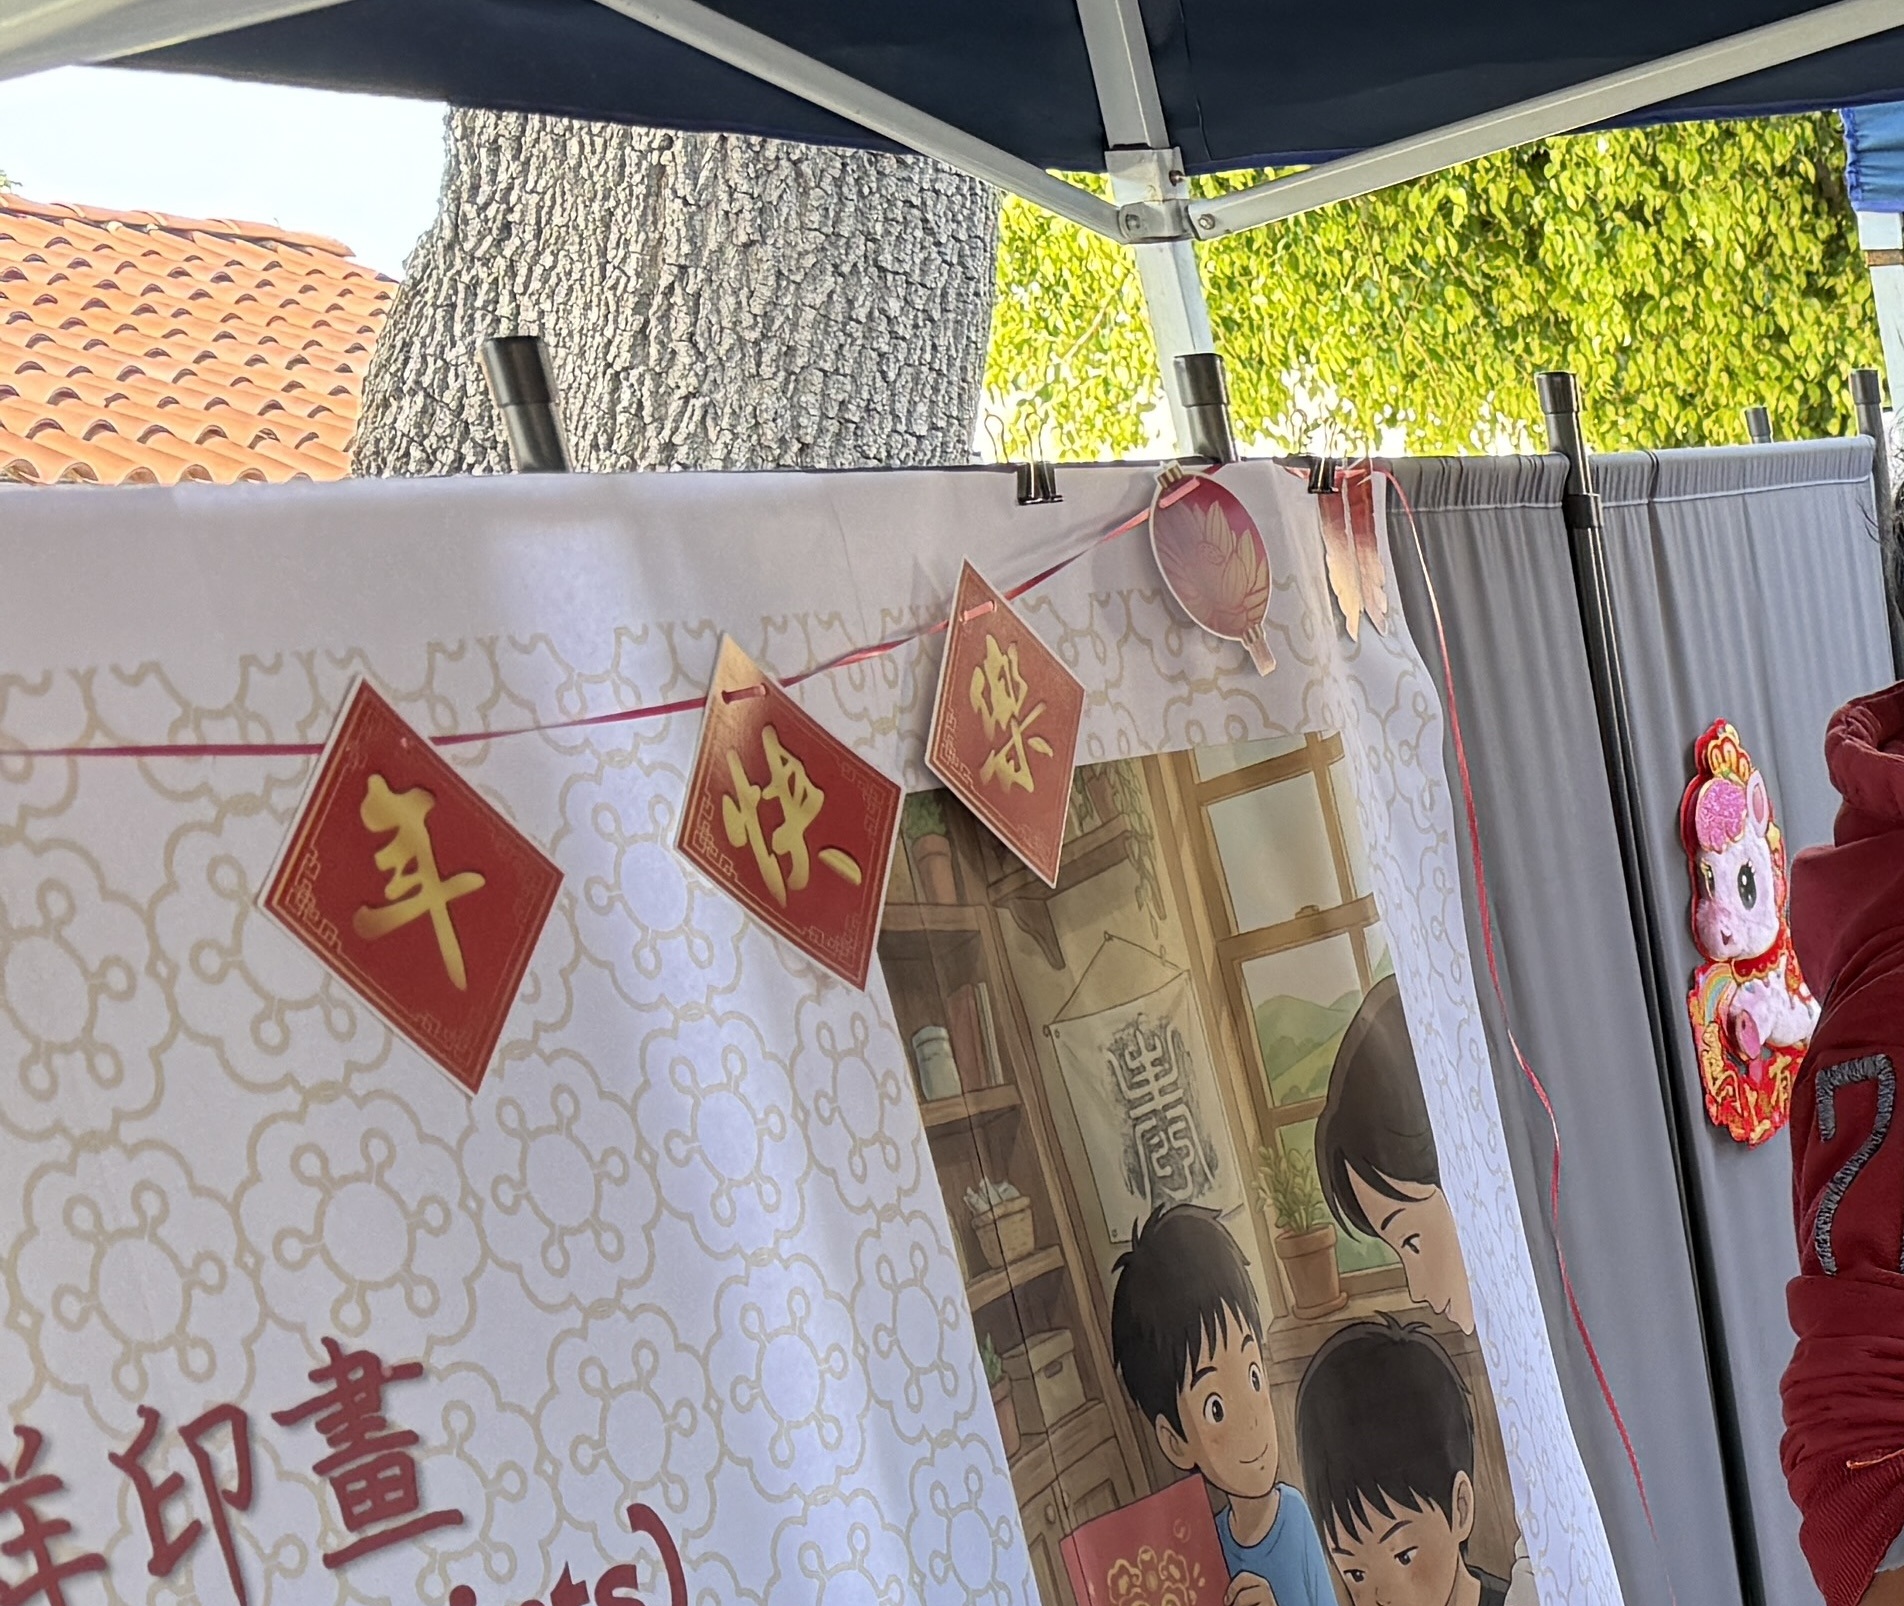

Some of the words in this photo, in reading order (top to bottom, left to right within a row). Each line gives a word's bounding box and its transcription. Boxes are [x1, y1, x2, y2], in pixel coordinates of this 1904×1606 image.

[352, 773, 486, 991] 年
[722, 724, 862, 908] 快
[970, 633, 1054, 793] 樂
